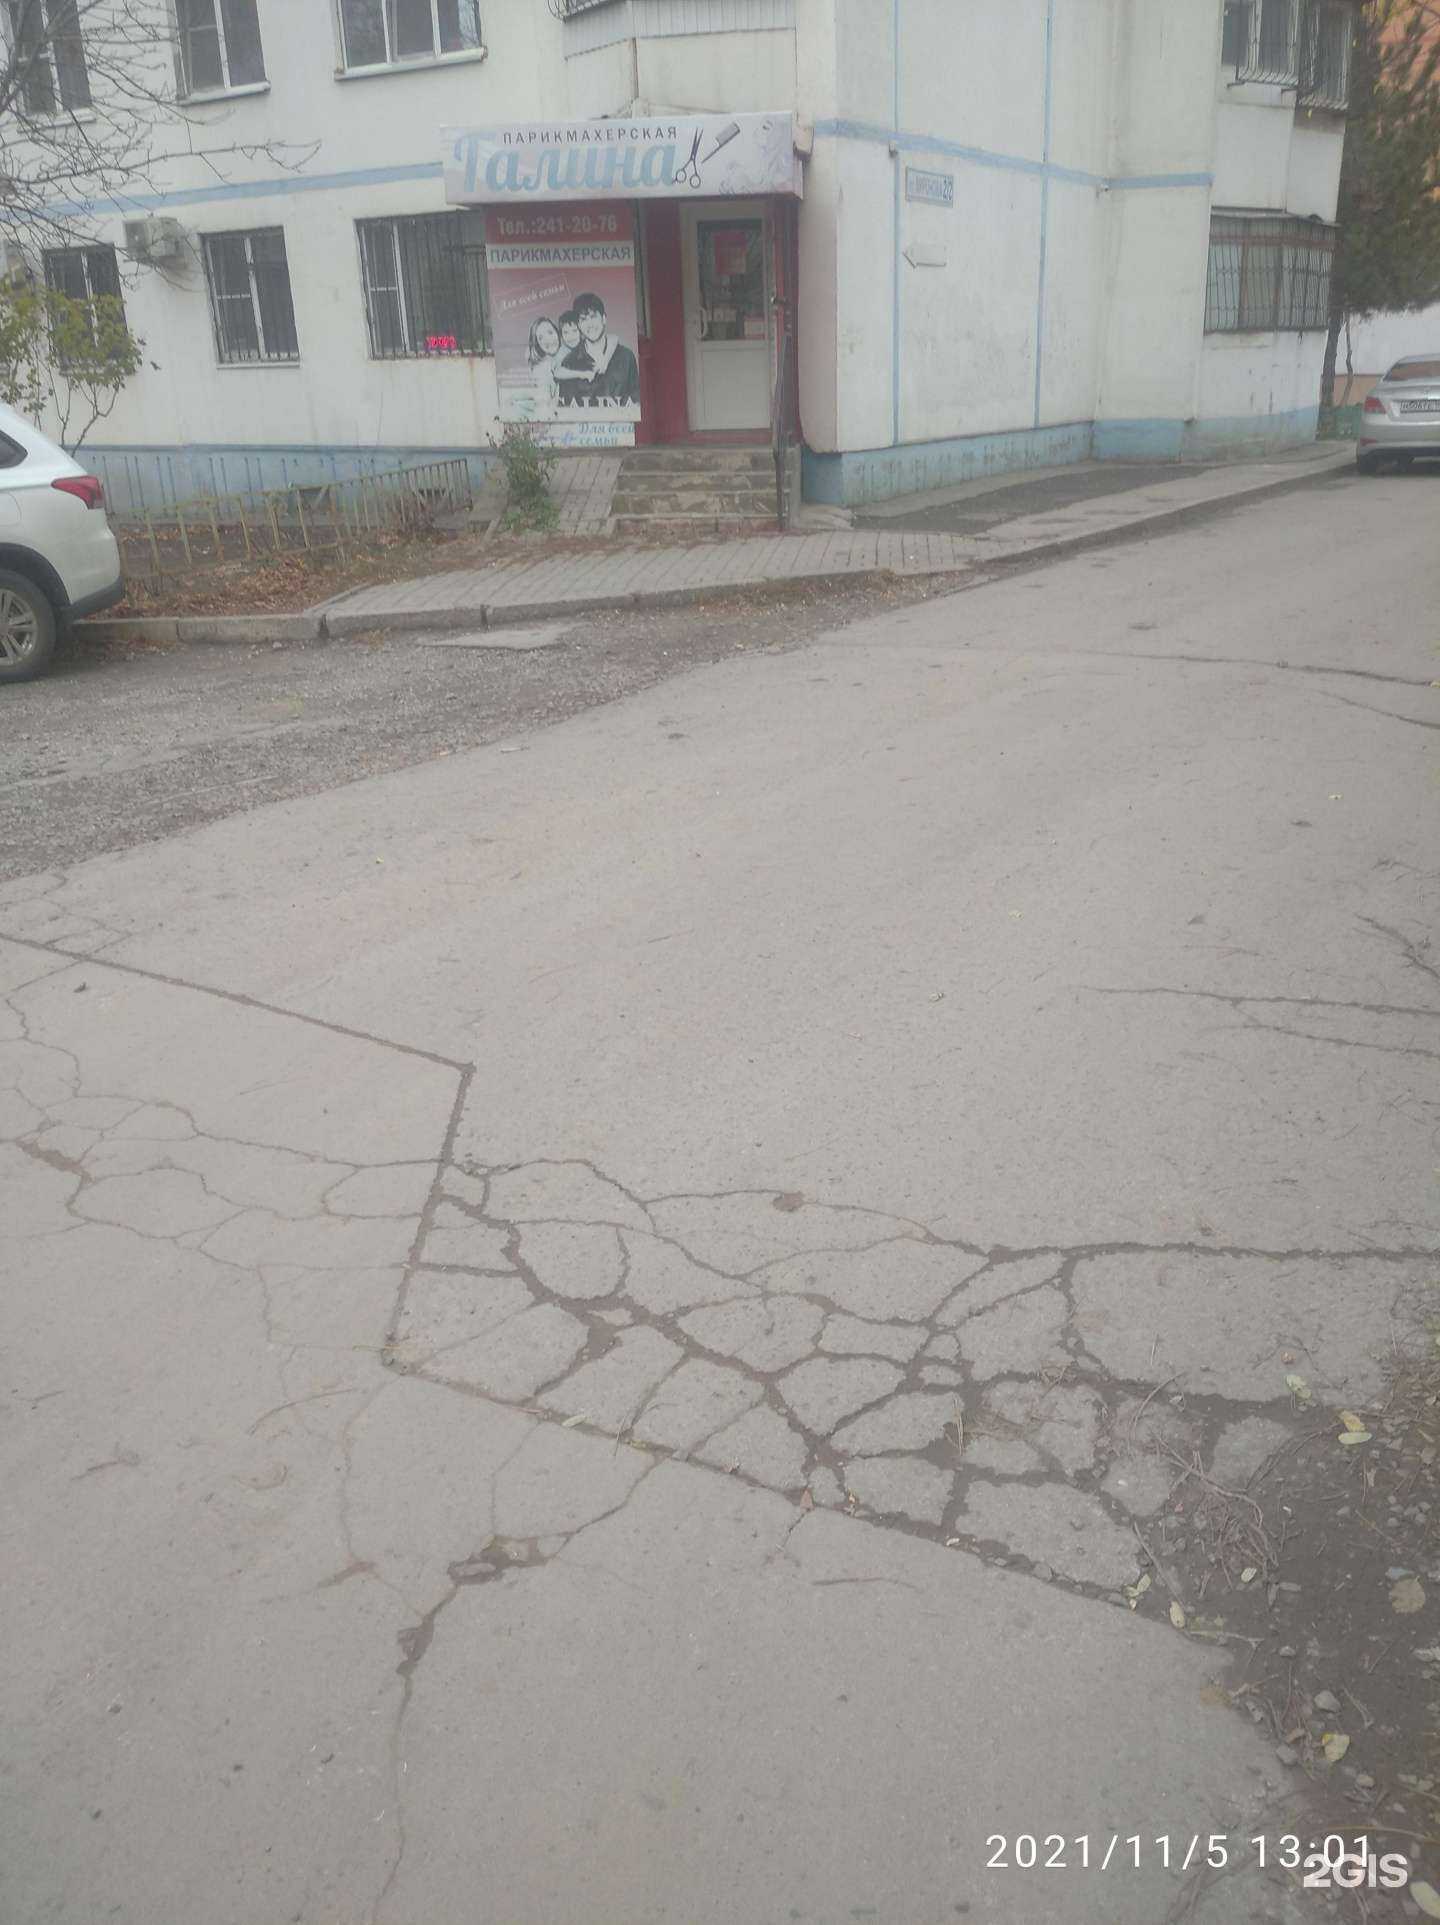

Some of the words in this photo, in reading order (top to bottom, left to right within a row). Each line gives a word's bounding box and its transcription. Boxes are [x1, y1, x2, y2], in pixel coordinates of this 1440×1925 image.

[503, 126, 678, 145] ПАРИКМАХЕРСКАЯ
[453, 130, 677, 193] Галина
[490, 246, 632, 263] ПАРИКМАХЕРСКАЯ
